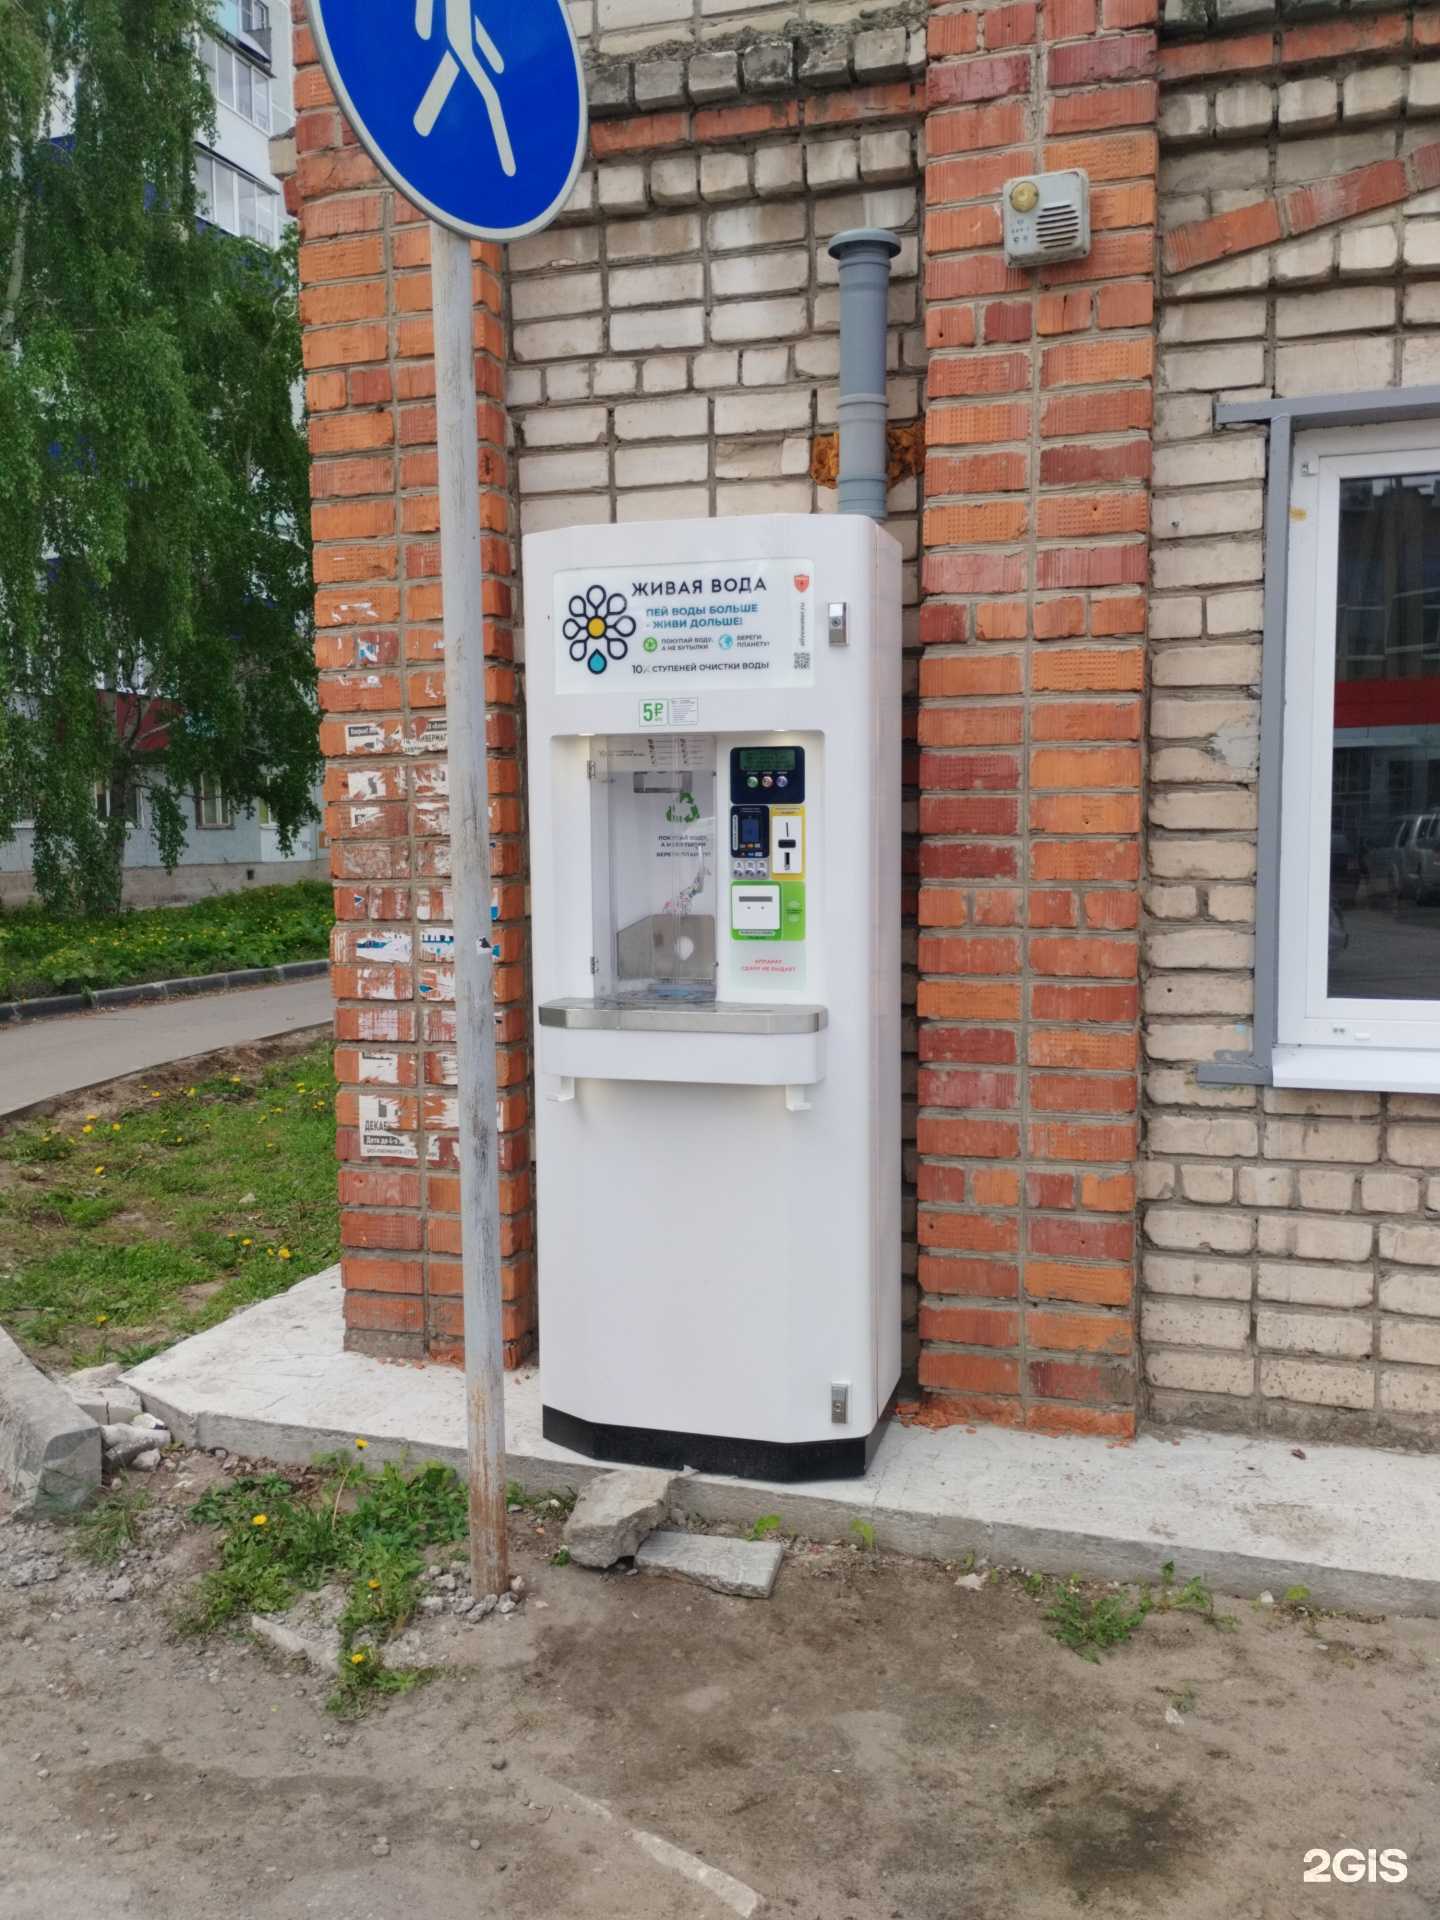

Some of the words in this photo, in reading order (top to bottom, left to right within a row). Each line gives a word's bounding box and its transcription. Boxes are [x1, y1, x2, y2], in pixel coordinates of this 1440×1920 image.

[632, 580, 703, 596] ЖИВАЯ
[711, 577, 767, 594] ВОДА
[646, 606, 669, 617] ПЕЙ
[672, 606, 706, 617] ВОДЫ
[709, 603, 758, 615] БОЛЬШЕ
[653, 620, 687, 629] ЖИВИ
[661, 636, 693, 644] ПОКУПАЙ
[652, 662, 697, 673] СТУПЕНЕЙ
[699, 662, 740, 671] ОЧИСТКИ
[742, 662, 769, 671] ВОДЫ
